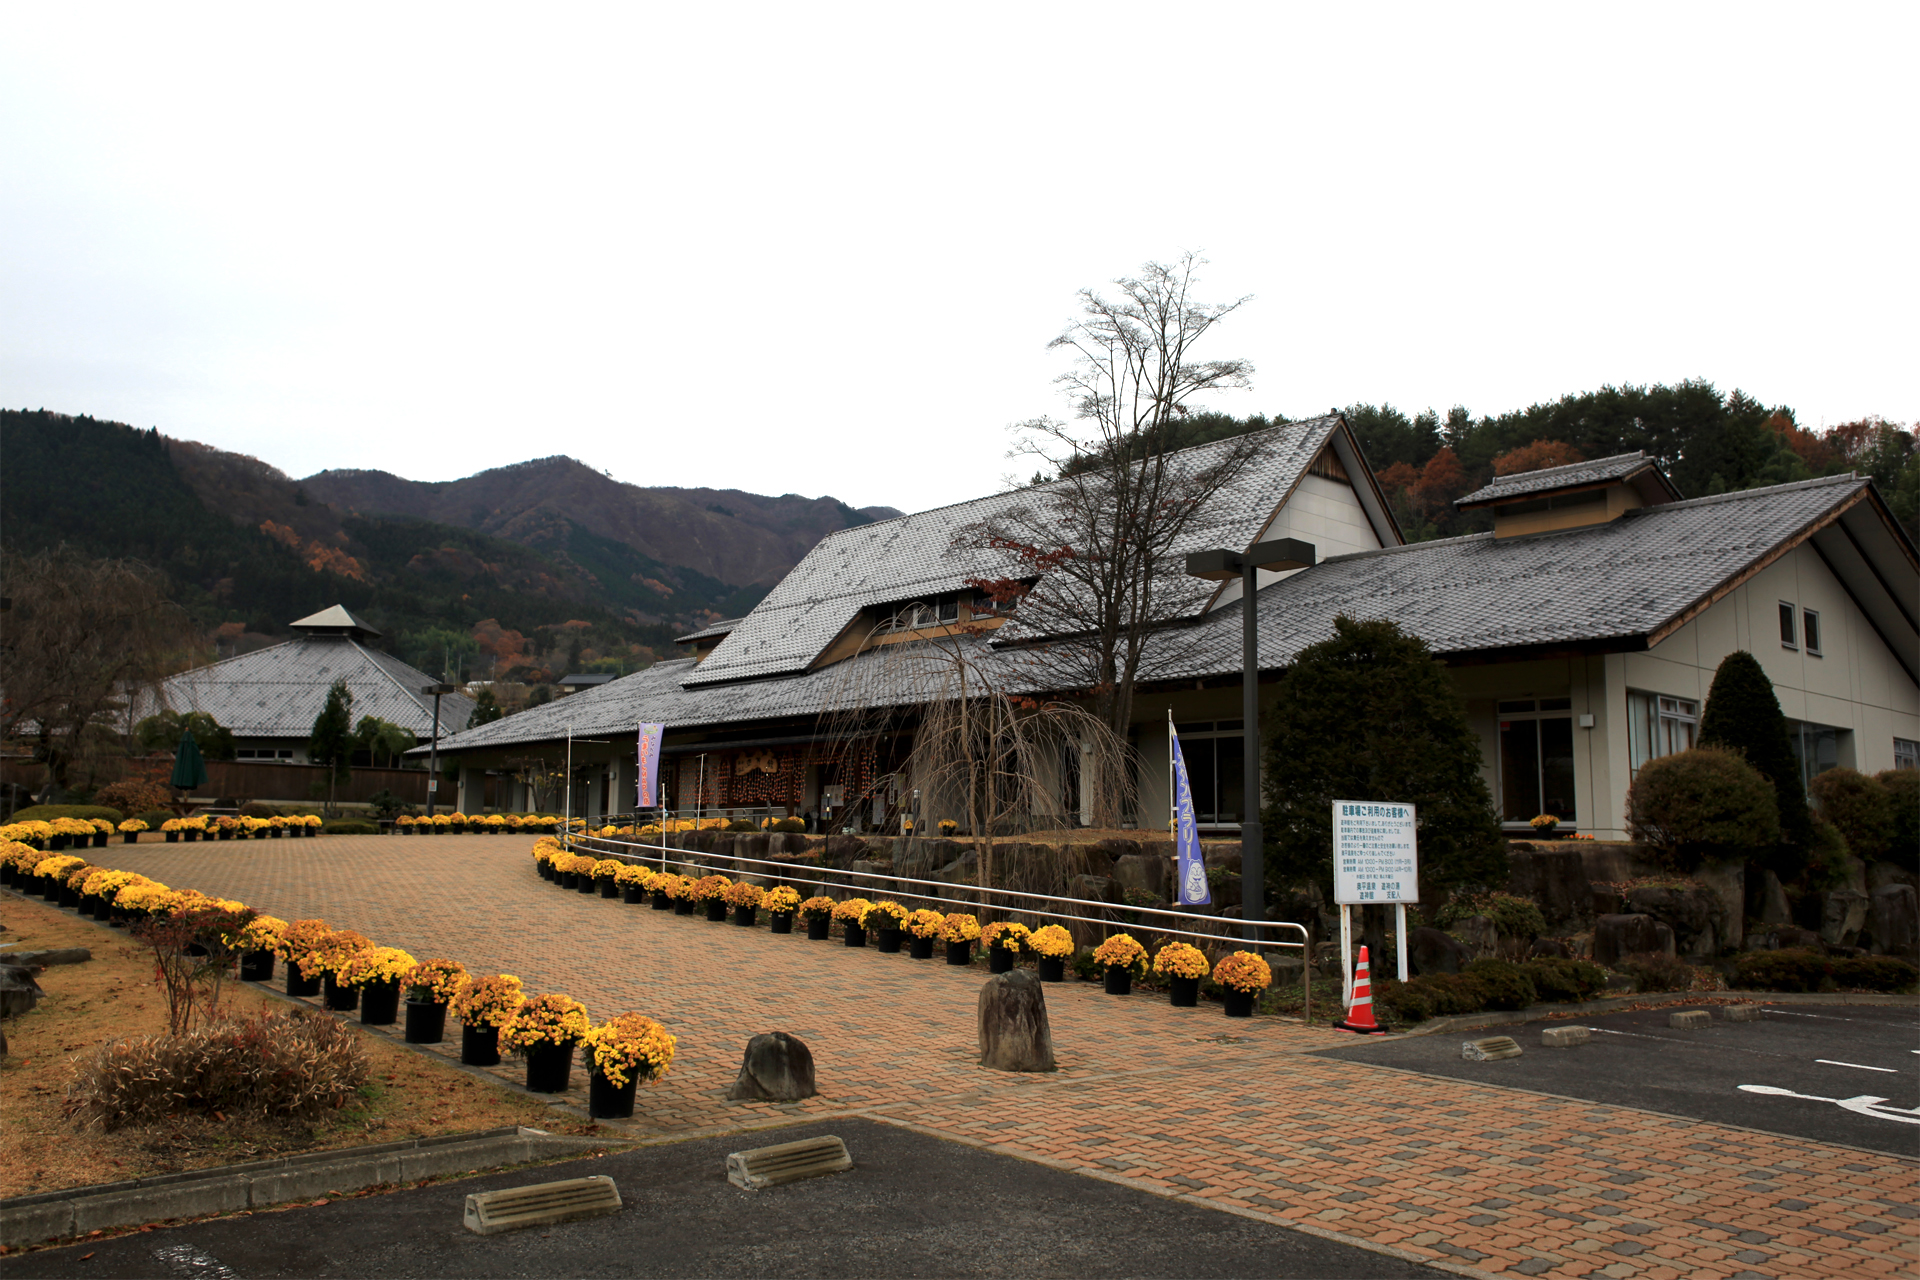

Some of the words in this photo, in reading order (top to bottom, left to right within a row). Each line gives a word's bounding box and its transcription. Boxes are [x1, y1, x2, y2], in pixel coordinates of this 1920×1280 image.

[1342, 805, 1410, 818] 駐車場ご利用のお客様へ
[1357, 882, 1376, 891] 奥平温泉
[1386, 891, 1401, 899] 支配人
